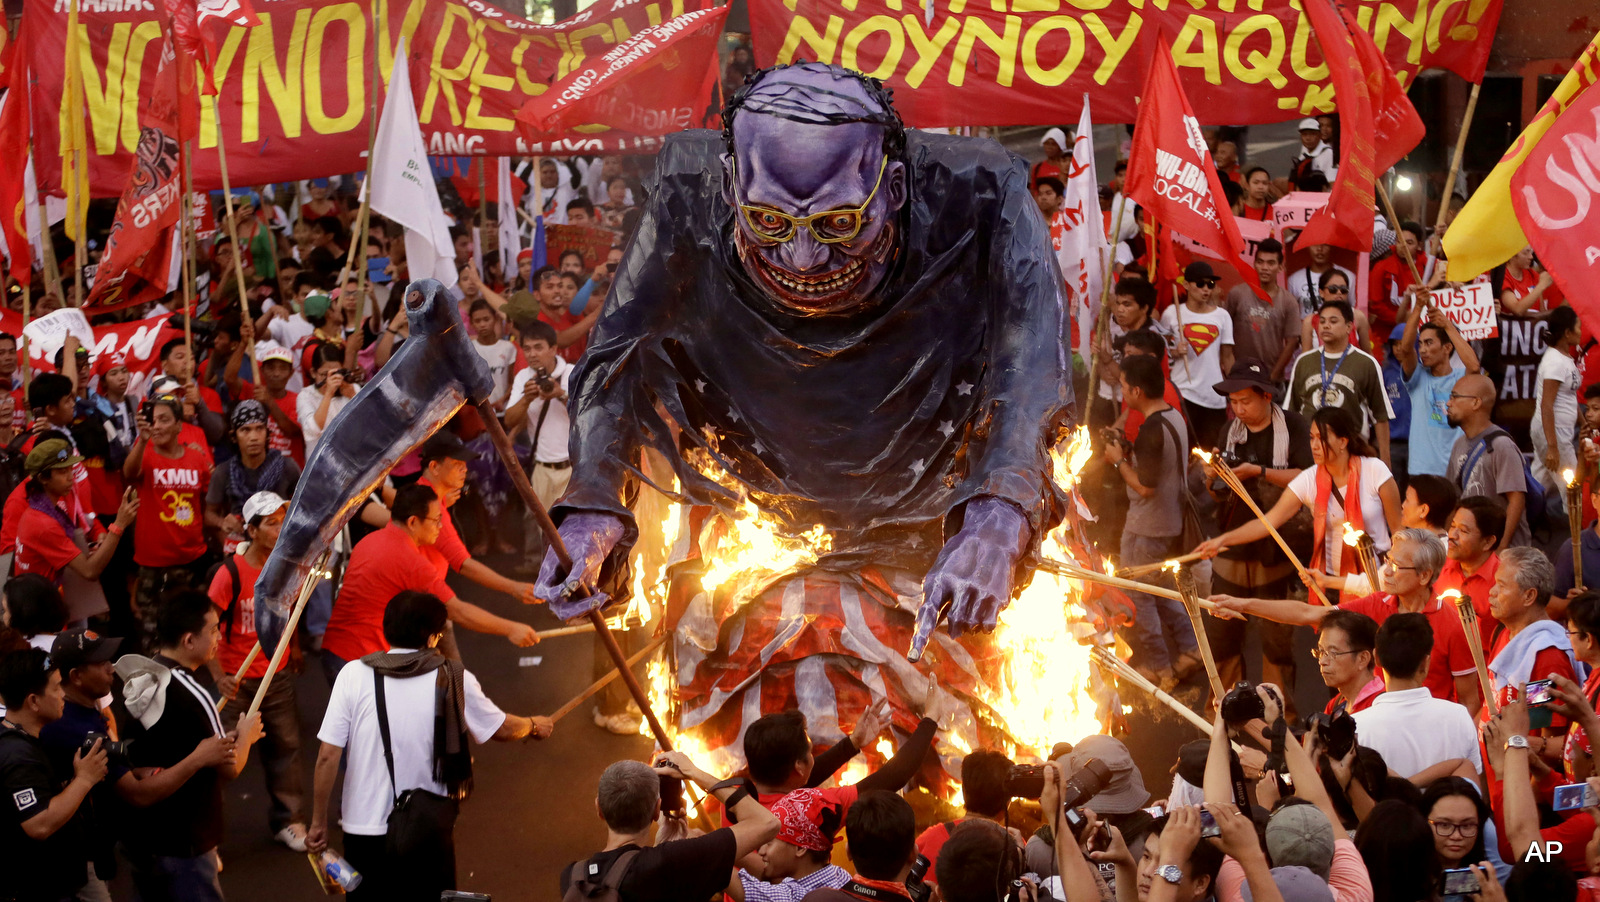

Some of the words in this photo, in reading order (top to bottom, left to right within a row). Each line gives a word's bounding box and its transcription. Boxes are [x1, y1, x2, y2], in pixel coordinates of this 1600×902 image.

[776, 11, 1144, 89] NOYNOY
[423, 130, 487, 154] ANG
[1500, 363, 1538, 399] AT
[153, 467, 199, 486] KMU
[853, 884, 877, 897] Canon
